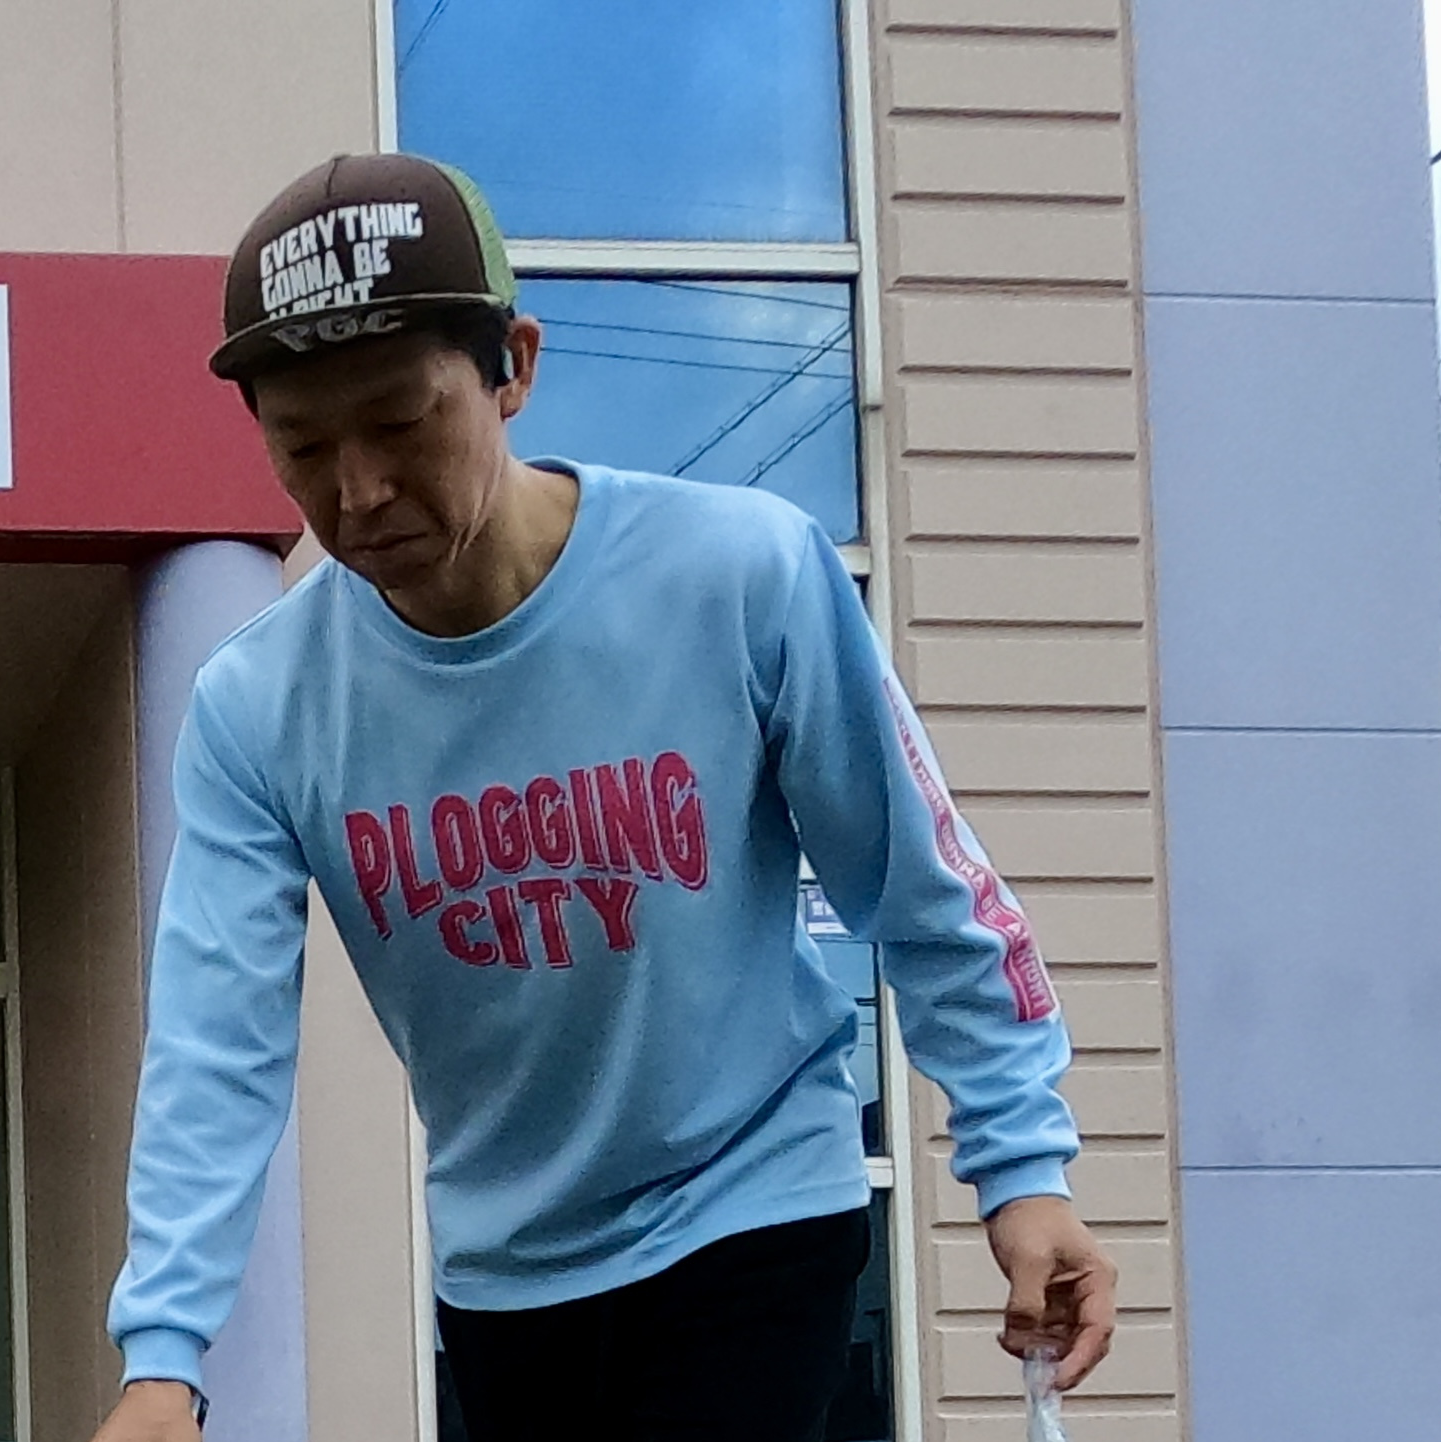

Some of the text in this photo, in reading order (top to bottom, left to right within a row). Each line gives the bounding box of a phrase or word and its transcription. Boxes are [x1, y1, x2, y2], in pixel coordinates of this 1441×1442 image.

[260, 202, 423, 280] EVERYTHING
[261, 238, 392, 313] GONNA BE
[344, 750, 709, 941] PLOGGING
[438, 877, 639, 970] CITY
